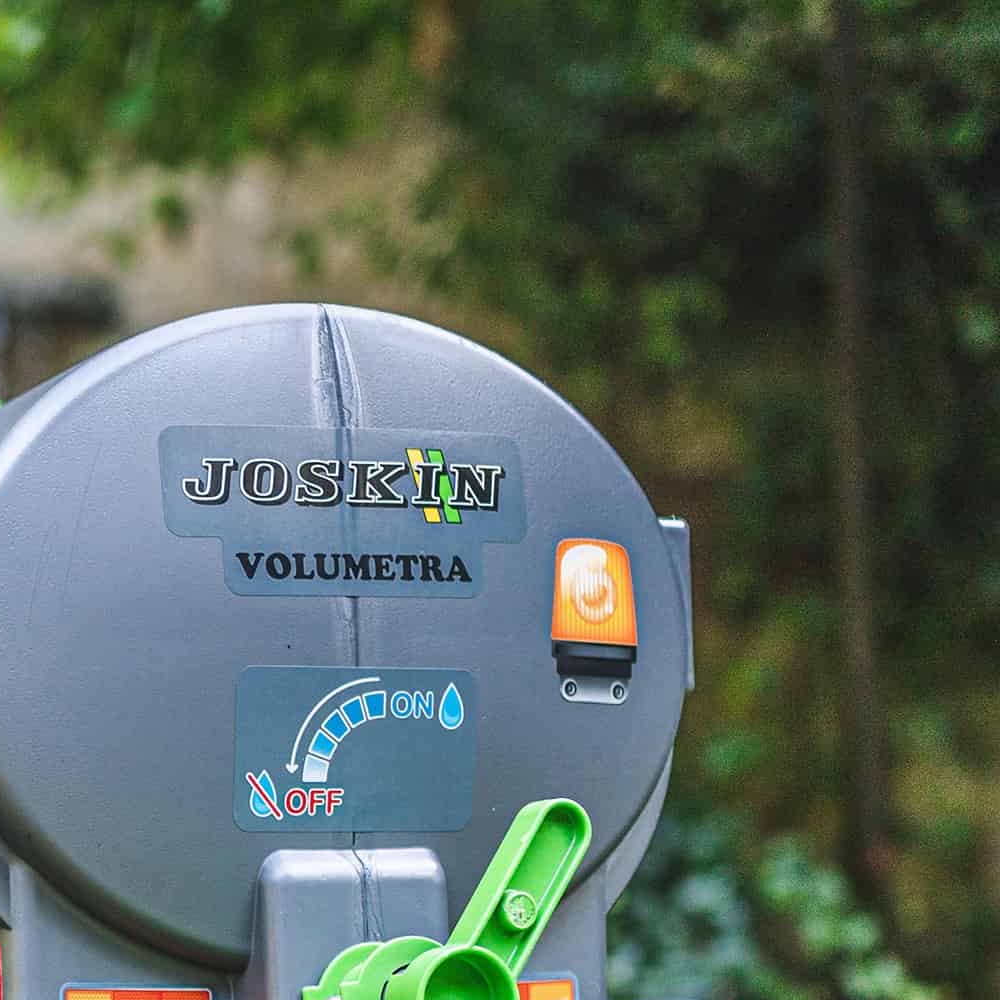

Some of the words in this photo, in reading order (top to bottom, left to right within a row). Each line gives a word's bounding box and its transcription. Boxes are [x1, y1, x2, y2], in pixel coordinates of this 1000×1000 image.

[183, 457, 504, 510] JOSKIN
[235, 552, 472, 582] VOLUMETRA
[390, 690, 434, 719] ON
[284, 788, 345, 816] OFF
